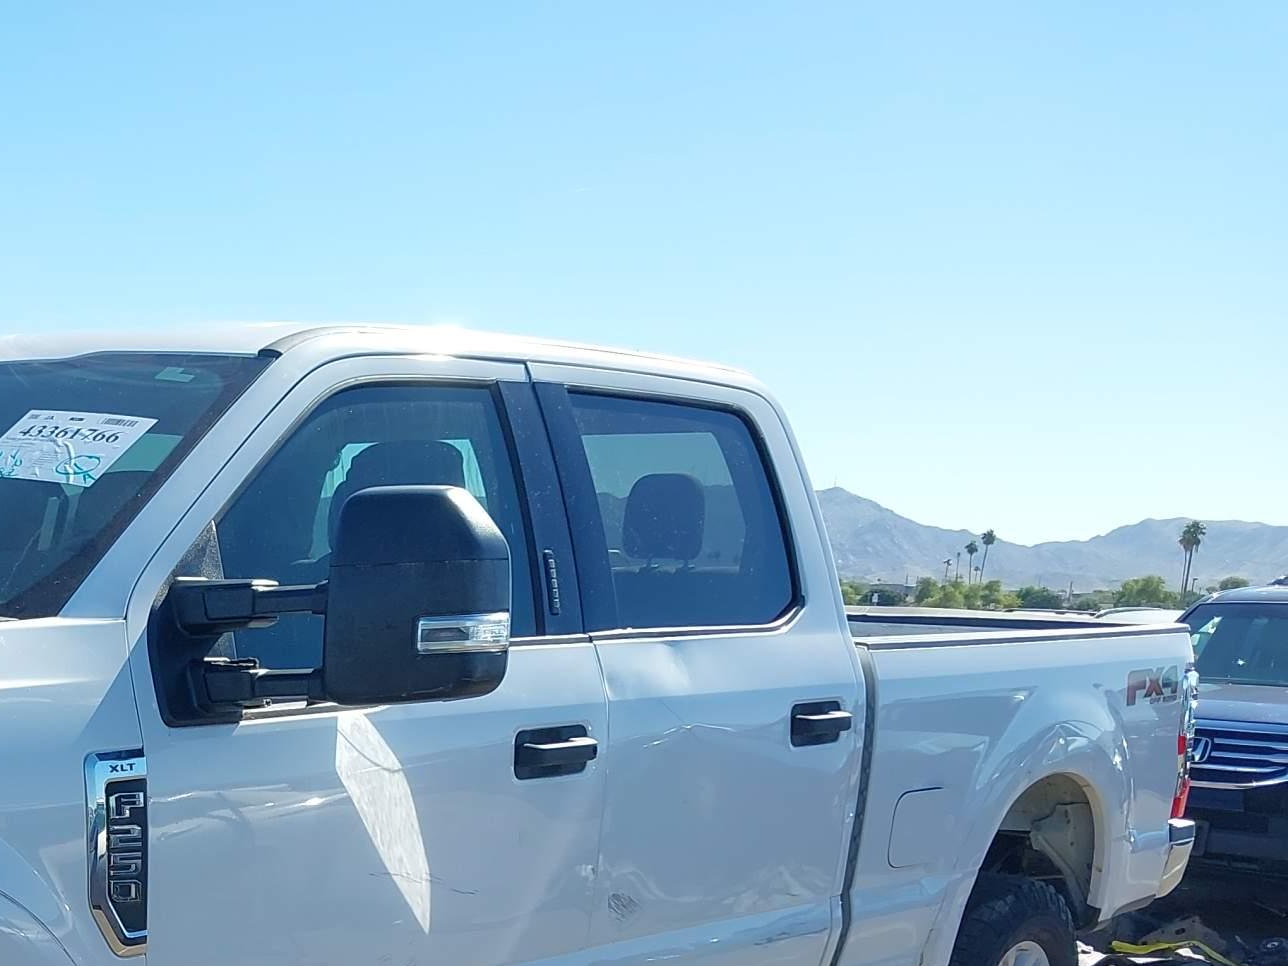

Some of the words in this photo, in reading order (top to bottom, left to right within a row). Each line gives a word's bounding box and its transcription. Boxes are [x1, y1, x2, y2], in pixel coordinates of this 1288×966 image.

[19, 424, 123, 443] 43361766
[1126, 664, 1178, 706] FX4
[109, 762, 136, 773] XLT
